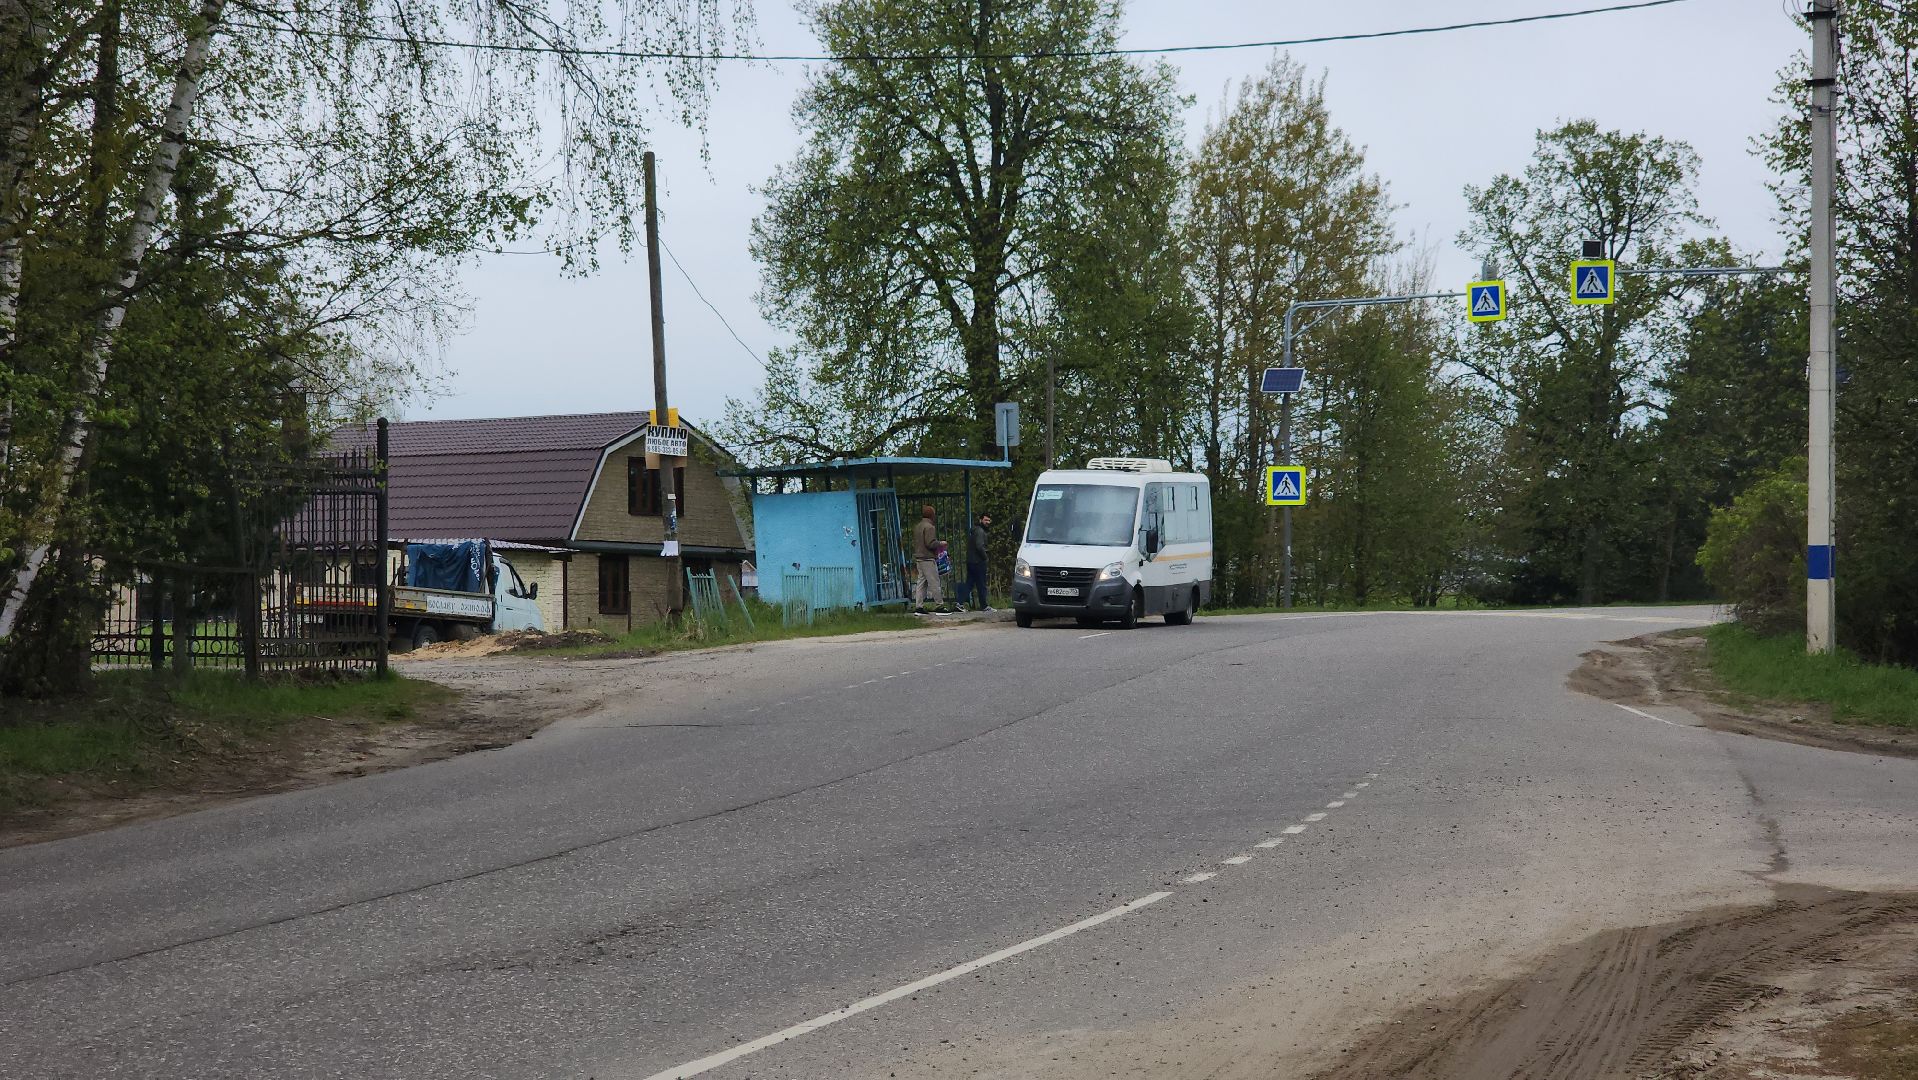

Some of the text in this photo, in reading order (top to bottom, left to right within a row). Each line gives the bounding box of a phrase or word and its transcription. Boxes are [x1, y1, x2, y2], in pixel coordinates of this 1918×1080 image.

[647, 426, 688, 439] КУПЛЮ
[647, 438, 687, 448] ЛЮБОЕ АВТО
